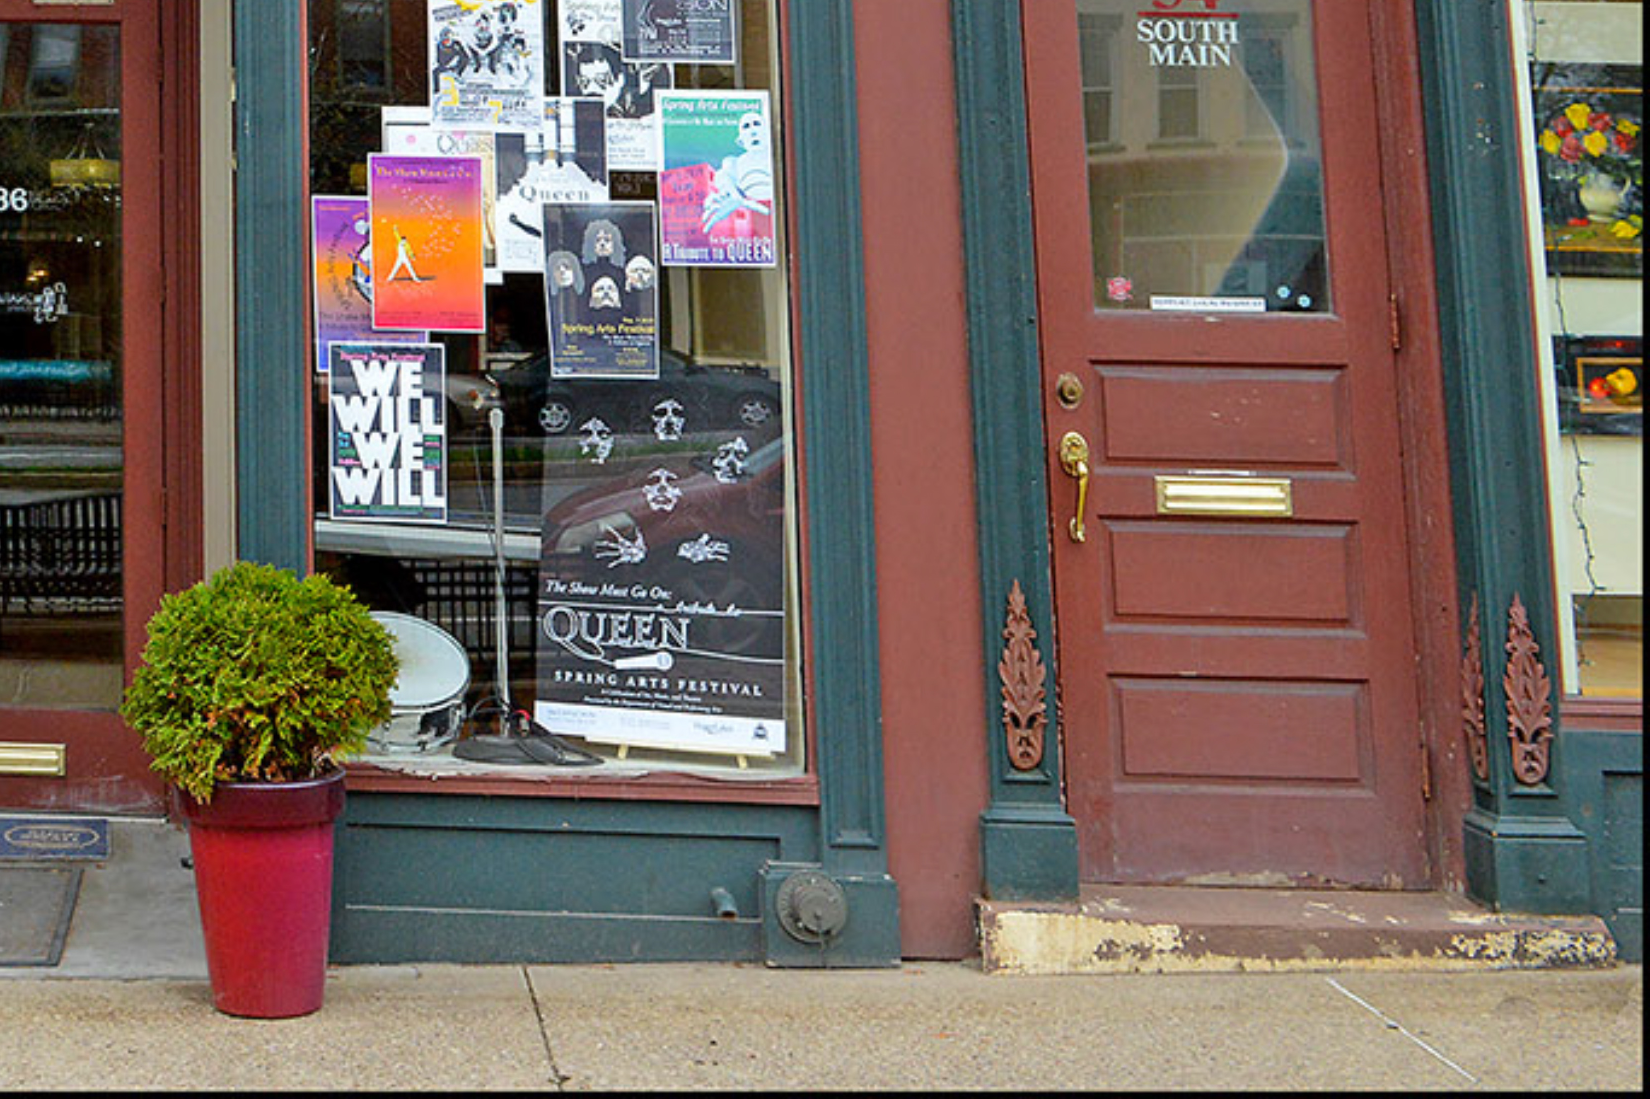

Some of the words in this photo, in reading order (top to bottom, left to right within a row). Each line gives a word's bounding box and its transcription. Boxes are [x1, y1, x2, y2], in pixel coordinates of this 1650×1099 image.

[1137, 19, 1240, 44] SOUTH
[1150, 44, 1231, 66] MAIN
[519, 185, 589, 201] Queen
[726, 244, 772, 261] QUEEN
[350, 359, 423, 396] WE
[331, 395, 445, 434] WILL
[351, 431, 423, 469] WE
[331, 466, 445, 508] WILL
[546, 579, 568, 593] The
[569, 581, 599, 596] Show
[600, 583, 630, 597] Must
[631, 585, 648, 598] Go
[543, 606, 691, 660] QUEEN
[555, 670, 617, 686] SPRING
[626, 677, 669, 690] ARTS
[678, 679, 763, 697] FESTIVAL
